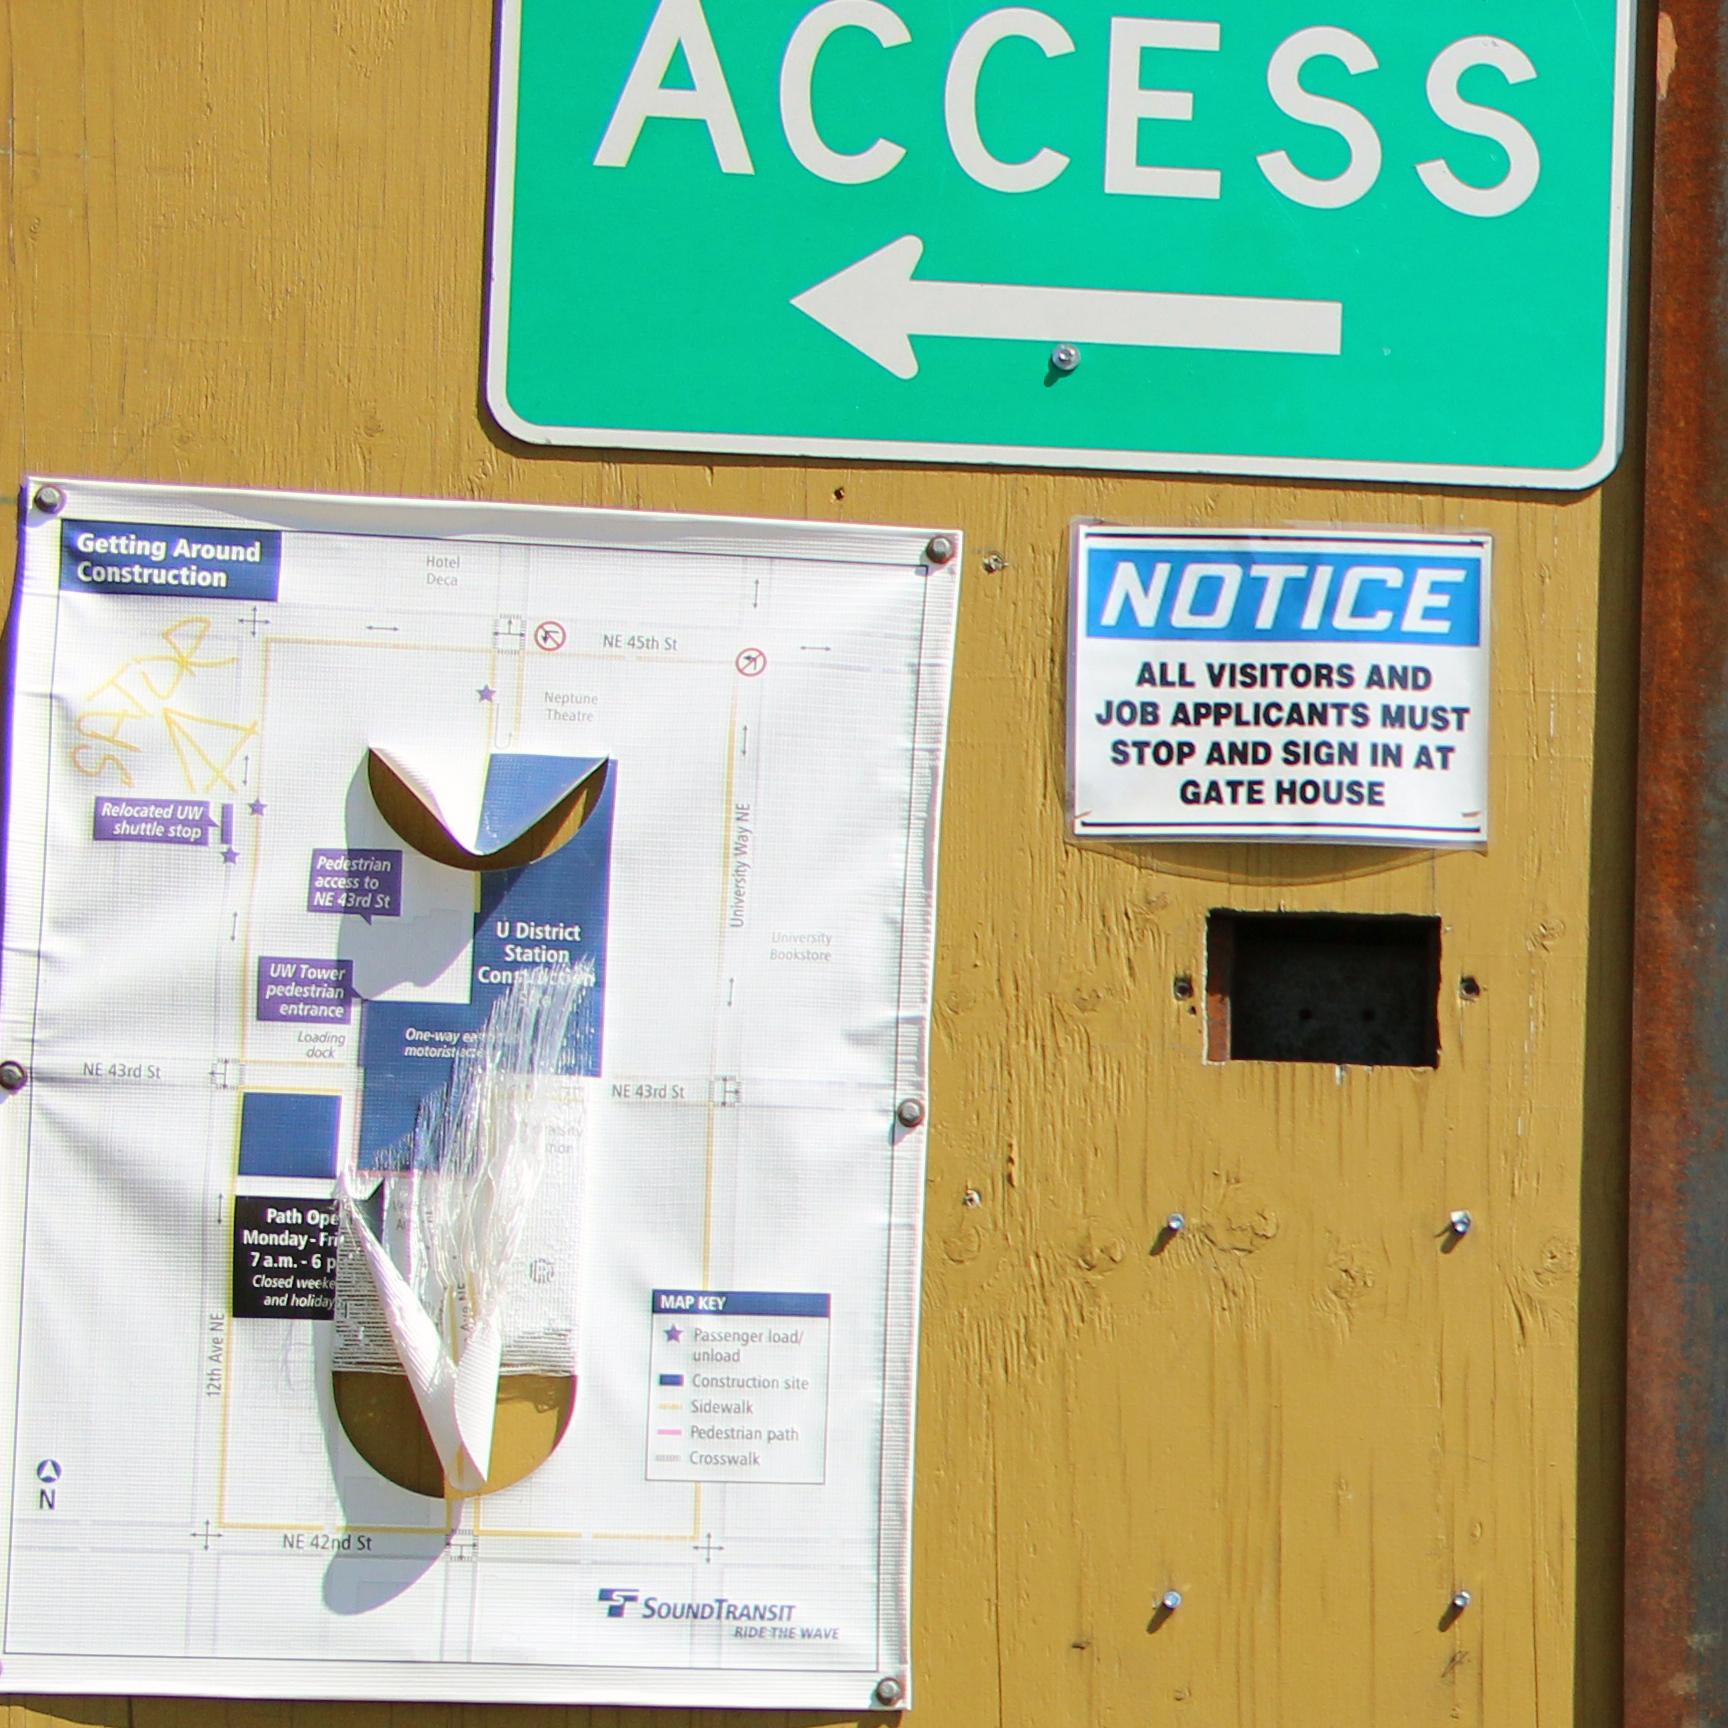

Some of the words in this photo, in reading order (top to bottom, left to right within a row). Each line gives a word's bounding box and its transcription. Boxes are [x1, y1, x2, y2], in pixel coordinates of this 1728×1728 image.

[593, 0, 1541, 218] ACCESS
[77, 532, 167, 561] Getting
[173, 539, 262, 563] Around
[426, 555, 460, 570] Hotel
[76, 561, 228, 588] Construction
[426, 572, 458, 587] Deca
[1100, 560, 1467, 634] NOTICE
[603, 634, 622, 649] NE
[627, 634, 660, 650] 45th
[663, 637, 678, 651] St
[1136, 661, 1196, 688] ALL
[1207, 662, 1354, 689] VISITORS
[1365, 665, 1432, 691] AND
[544, 691, 598, 707] Neptune
[546, 708, 594, 723] Theatre
[1095, 699, 1160, 726] JOB
[1170, 701, 1370, 728] APPLICANTS
[1381, 704, 1471, 731] MUST
[1110, 740, 1195, 767] STOP
[1206, 741, 1272, 767] AND
[1282, 742, 1359, 768] SIGN
[1371, 743, 1402, 769] IN
[1414, 745, 1455, 771] AT
[1180, 780, 1265, 806] GATE
[1275, 780, 1386, 806] HOUSE
[101, 803, 172, 820] Relocated
[176, 806, 204, 820] UW
[736, 802, 751, 823] NE
[113, 820, 166, 837] shuttle
[169, 824, 202, 841] stop
[733, 828, 752, 865] Way
[317, 855, 392, 873] Pedestrian
[315, 876, 360, 890] access
[363, 875, 380, 891] to
[314, 891, 337, 907] NE
[341, 892, 372, 909] 43rd
[375, 894, 391, 909] St
[729, 867, 748, 929] University
[497, 922, 510, 939] U
[516, 922, 582, 943] District
[771, 932, 832, 949] University
[504, 944, 570, 964] Station
[770, 948, 832, 963] Bookstore
[270, 963, 296, 979] UW
[299, 964, 346, 981] Tower
[266, 982, 345, 1001] pedestrian
[279, 1003, 344, 1018] entrance
[297, 1031, 346, 1047] Loading
[406, 1028, 461, 1044] One-way
[306, 1046, 336, 1060] dock
[83, 1062, 103, 1077] NE
[108, 1062, 143, 1079] 43rd
[147, 1064, 161, 1080] St
[612, 1084, 631, 1099] NE
[635, 1084, 668, 1100] 43rd
[671, 1085, 685, 1100] St
[266, 1208, 302, 1225] Path
[307, 1209, 339, 1229] Ope
[243, 1229, 308, 1251] Monday
[319, 1231, 340, 1248] Fri
[250, 1251, 261, 1268] 7
[263, 1255, 298, 1269] a.m.
[311, 1253, 322, 1269] 6
[252, 1274, 295, 1289] Closed
[296, 1277, 337, 1290] weeke
[264, 1293, 289, 1307] and
[290, 1293, 336, 1311] holiday
[660, 1295, 695, 1310] MAP
[698, 1296, 727, 1311] KEY
[209, 1312, 225, 1333] NE
[693, 1327, 764, 1346] Passenger
[768, 1328, 805, 1346] load/
[207, 1336, 224, 1364] Ave
[693, 1348, 741, 1363] unload
[206, 1365, 223, 1398] 12th
[692, 1374, 780, 1391] Construction
[784, 1376, 810, 1391] site
[690, 1399, 754, 1416] Sidewalk
[690, 1425, 763, 1442] Pedestrian
[767, 1427, 800, 1444] path
[689, 1450, 761, 1468] Crosswalk
[39, 1489, 55, 1510] N
[283, 1534, 305, 1549] NE
[310, 1534, 352, 1551] 42nd
[356, 1535, 372, 1552] St
[734, 1626, 769, 1640] RIDE
[772, 1627, 796, 1640] THE
[800, 1627, 840, 1641] WAVE
